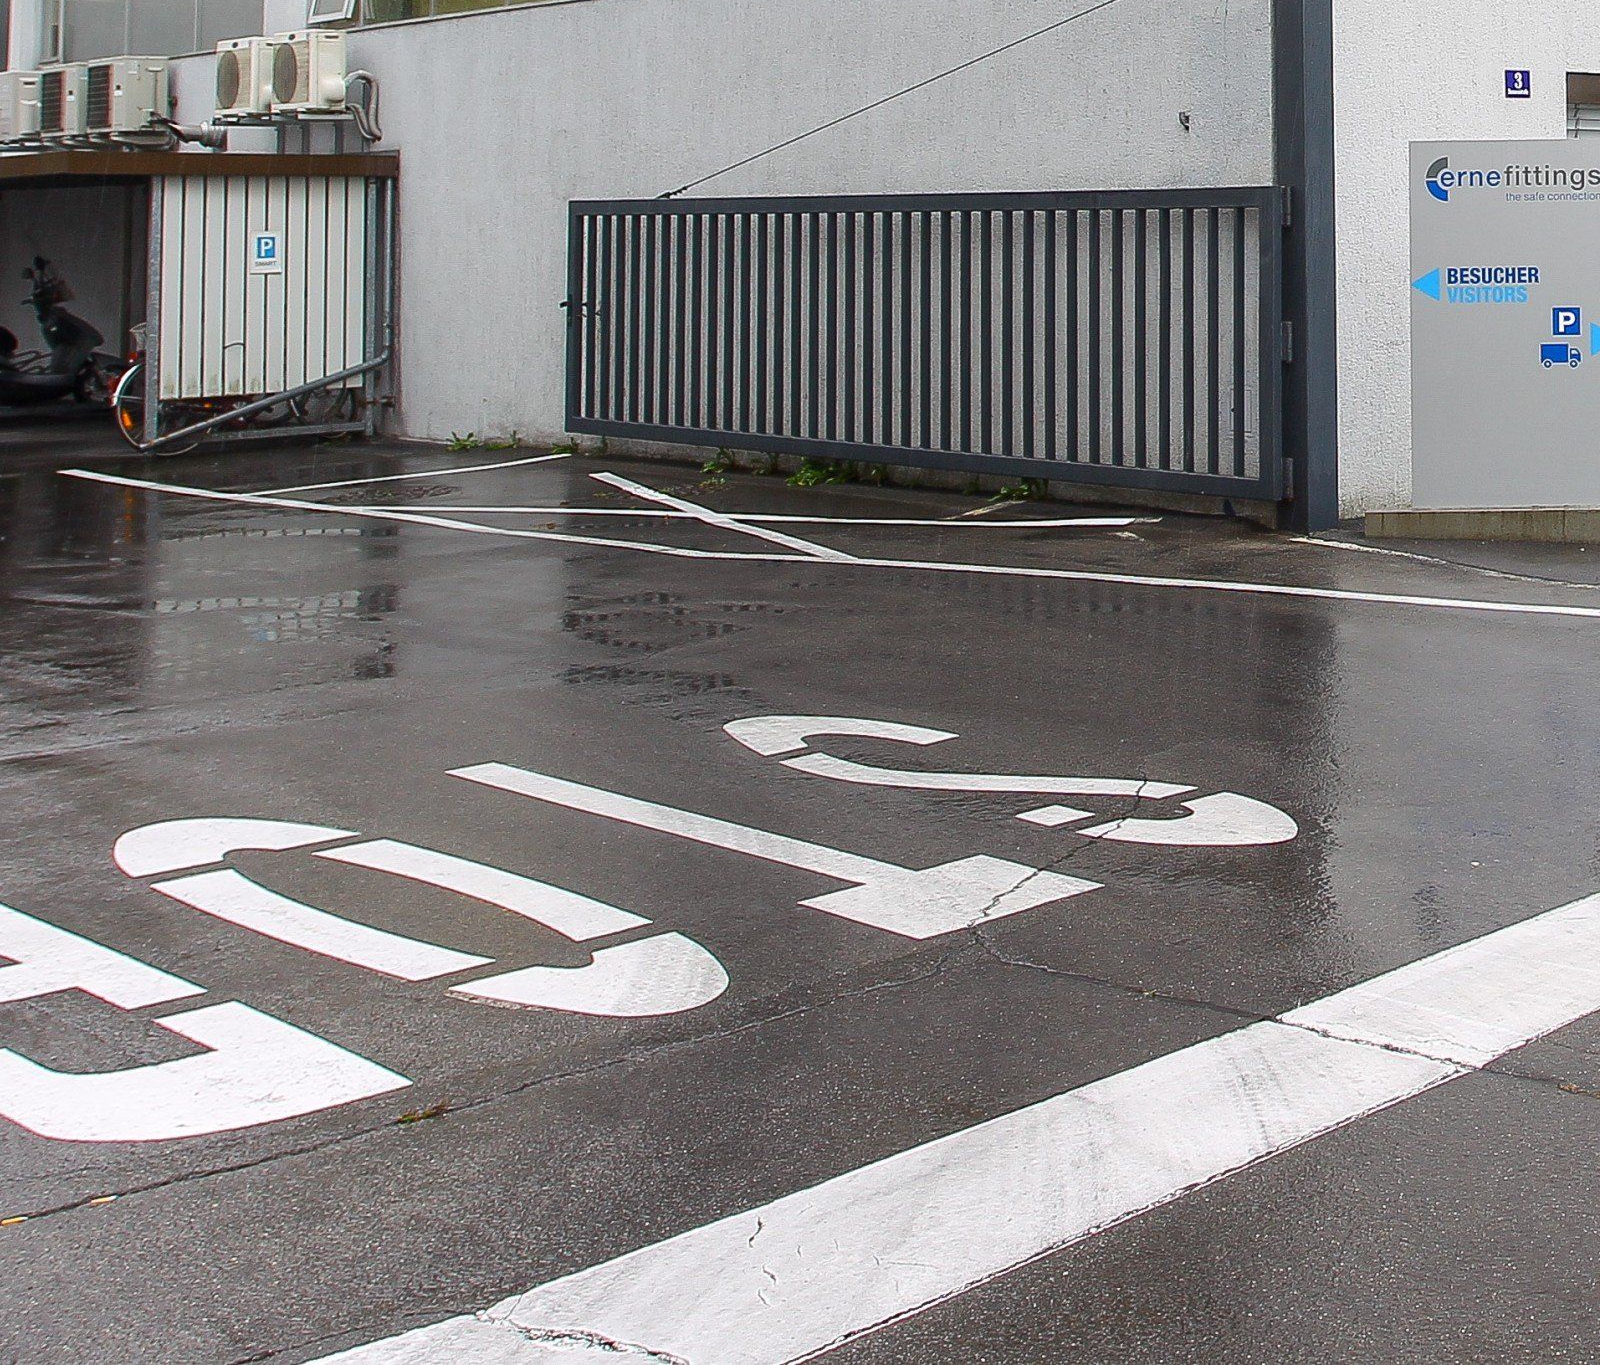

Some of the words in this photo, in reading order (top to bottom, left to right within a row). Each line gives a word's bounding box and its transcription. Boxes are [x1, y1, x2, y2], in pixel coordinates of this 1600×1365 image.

[1513, 71, 1523, 89] 3
[1505, 192, 1521, 202] the
[1523, 191, 1545, 202] safe
[260, 238, 273, 257] P
[1446, 267, 1540, 285] BESUCHER
[1446, 286, 1528, 303] VISITORS
[1558, 311, 1576, 333] P
